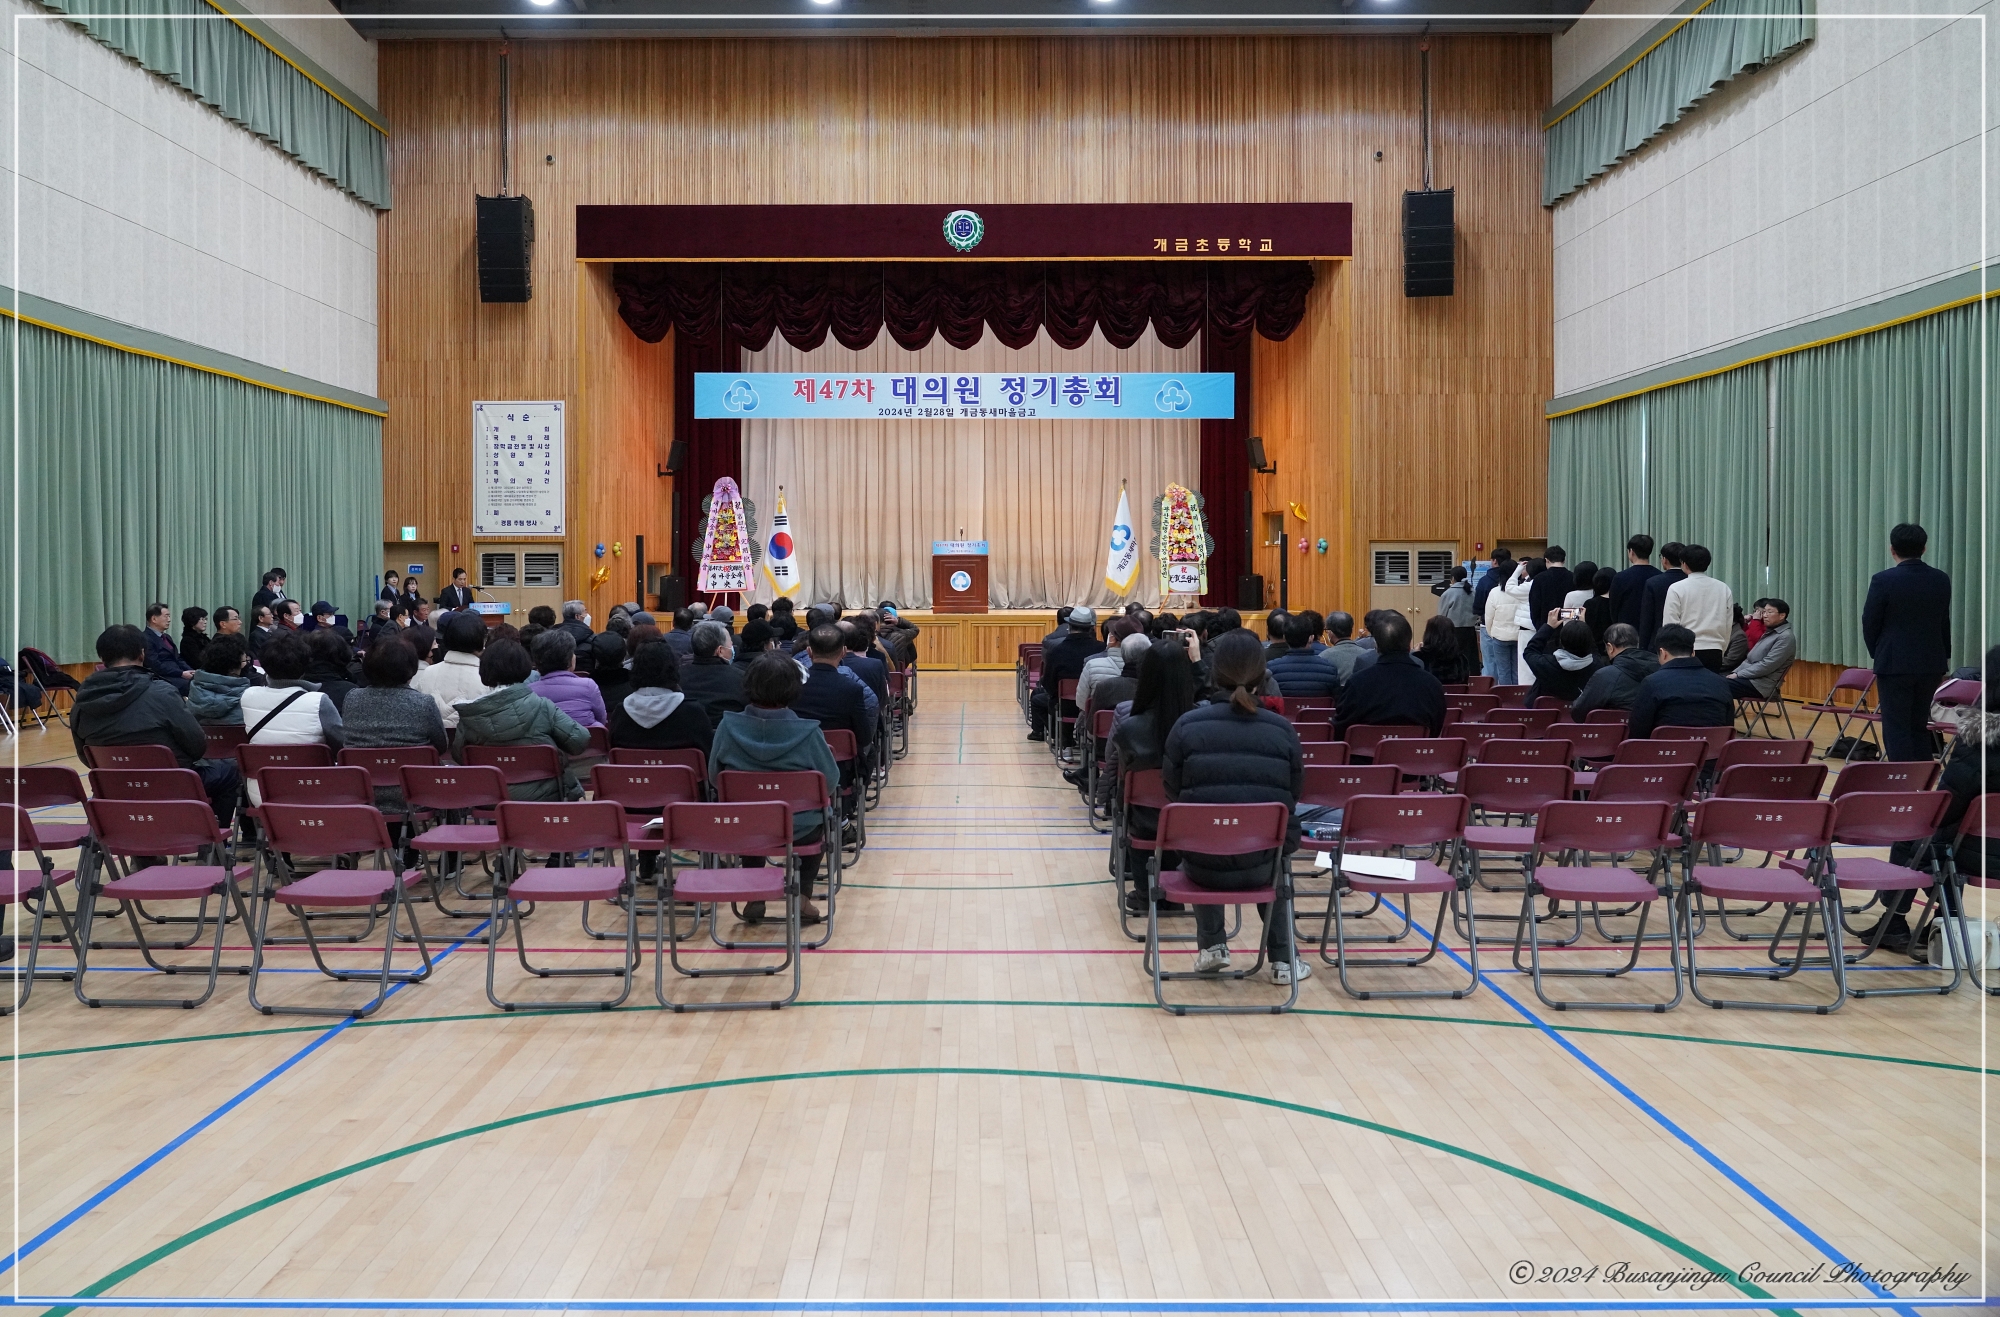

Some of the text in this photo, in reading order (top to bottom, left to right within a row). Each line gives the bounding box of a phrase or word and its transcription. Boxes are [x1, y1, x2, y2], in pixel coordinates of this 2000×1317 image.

[1153, 238, 1273, 252] 개금초등학교
[793, 375, 1121, 405] 제47차 대의원 정기총회
[878, 407, 1036, 417] 2024년 2월28일 개금동새마을금고
[128, 814, 154, 822] 개금초
[1213, 818, 1239, 826] 개금초
[300, 819, 325, 827] 개금초
